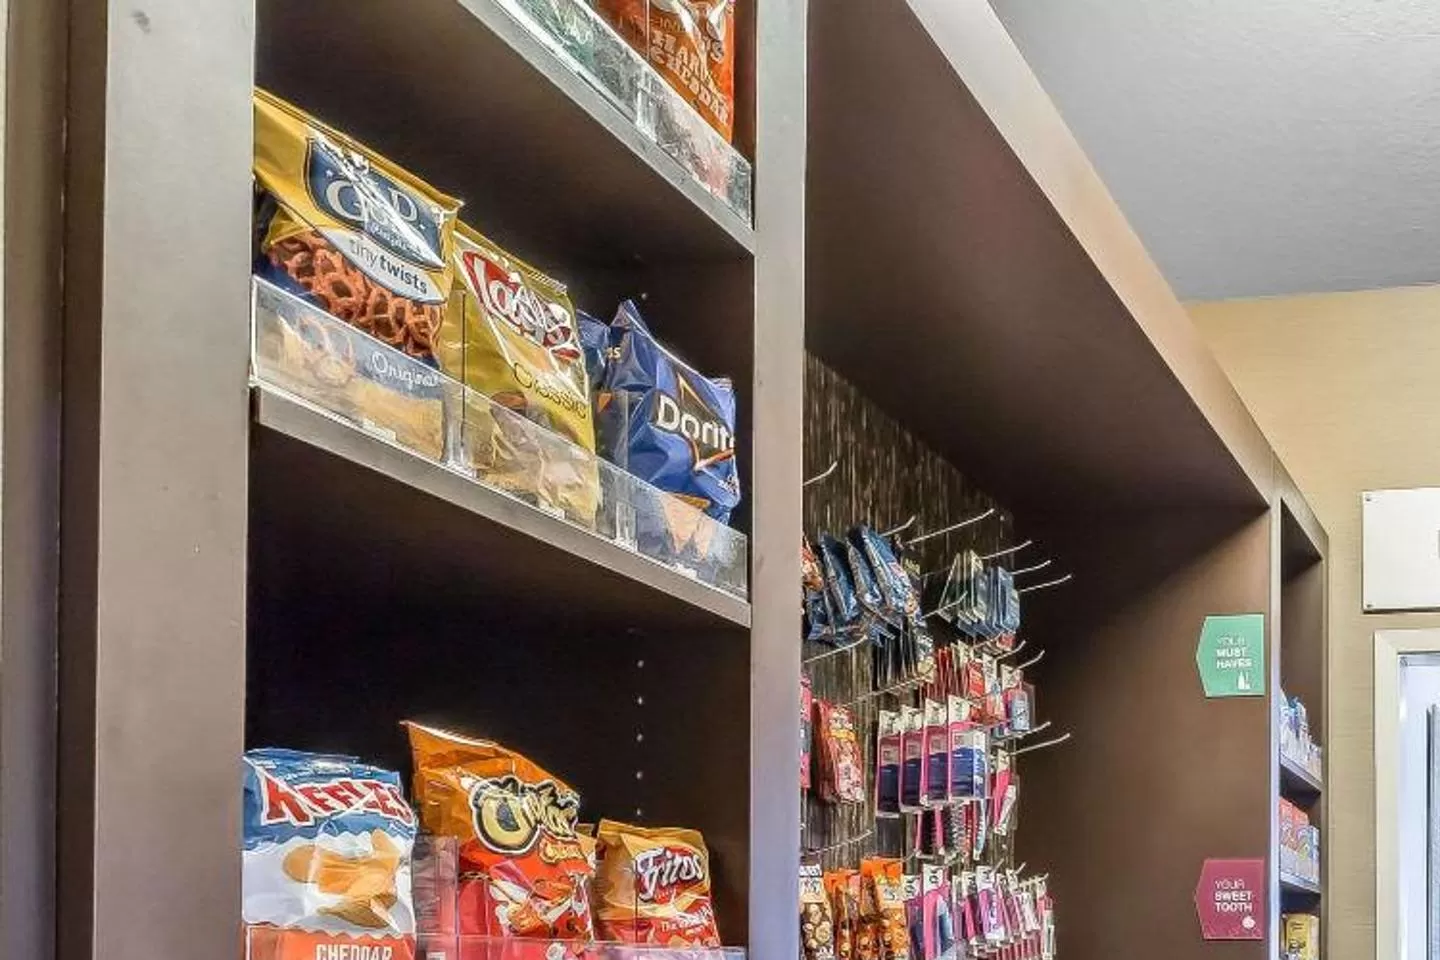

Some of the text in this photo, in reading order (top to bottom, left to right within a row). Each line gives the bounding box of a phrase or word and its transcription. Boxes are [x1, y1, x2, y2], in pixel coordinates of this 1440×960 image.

[349, 239, 428, 295] tiny twists
[657, 394, 735, 451] Dorit
[1216, 648, 1246, 657] MUST
[1216, 658, 1252, 669] HAVES
[262, 776, 416, 827] RFFLES
[636, 848, 705, 901] Fritos
[1214, 879, 1245, 889] YOUR
[1214, 891, 1253, 901] SWEET
[1214, 902, 1253, 913] TOOTH
